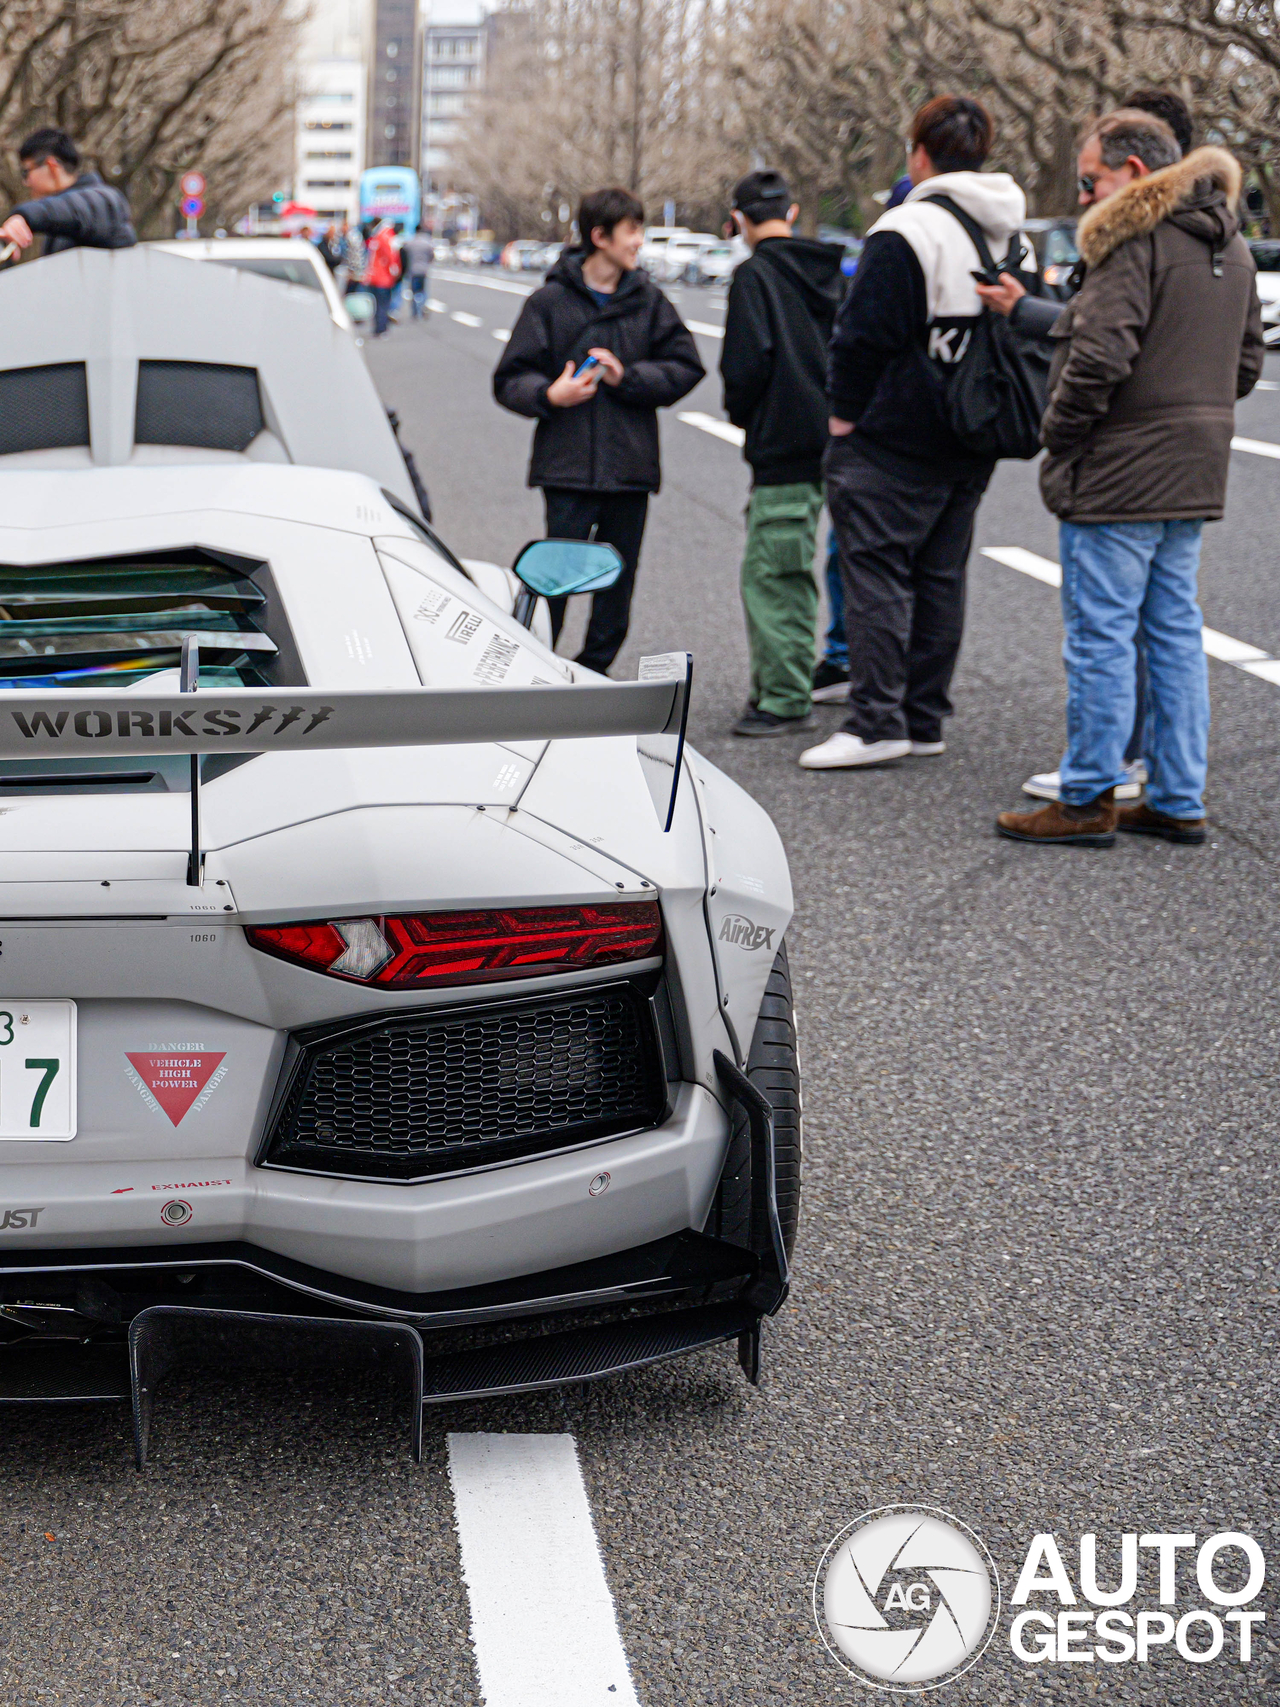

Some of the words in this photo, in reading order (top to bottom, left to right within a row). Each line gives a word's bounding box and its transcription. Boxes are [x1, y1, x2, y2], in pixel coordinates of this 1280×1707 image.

[444, 610, 484, 646] PIRELLI
[10, 709, 242, 738] WORKS
[189, 933, 217, 943] 1060
[147, 1042, 205, 1051] DANGER
[149, 1059, 202, 1068] VEHICLE
[159, 1069, 191, 1078] HIGH
[123, 1066, 159, 1113] DANGER
[152, 1080, 198, 1088] POWER
[192, 1066, 229, 1112] DANGER
[151, 1178, 233, 1191] EXHAUST
